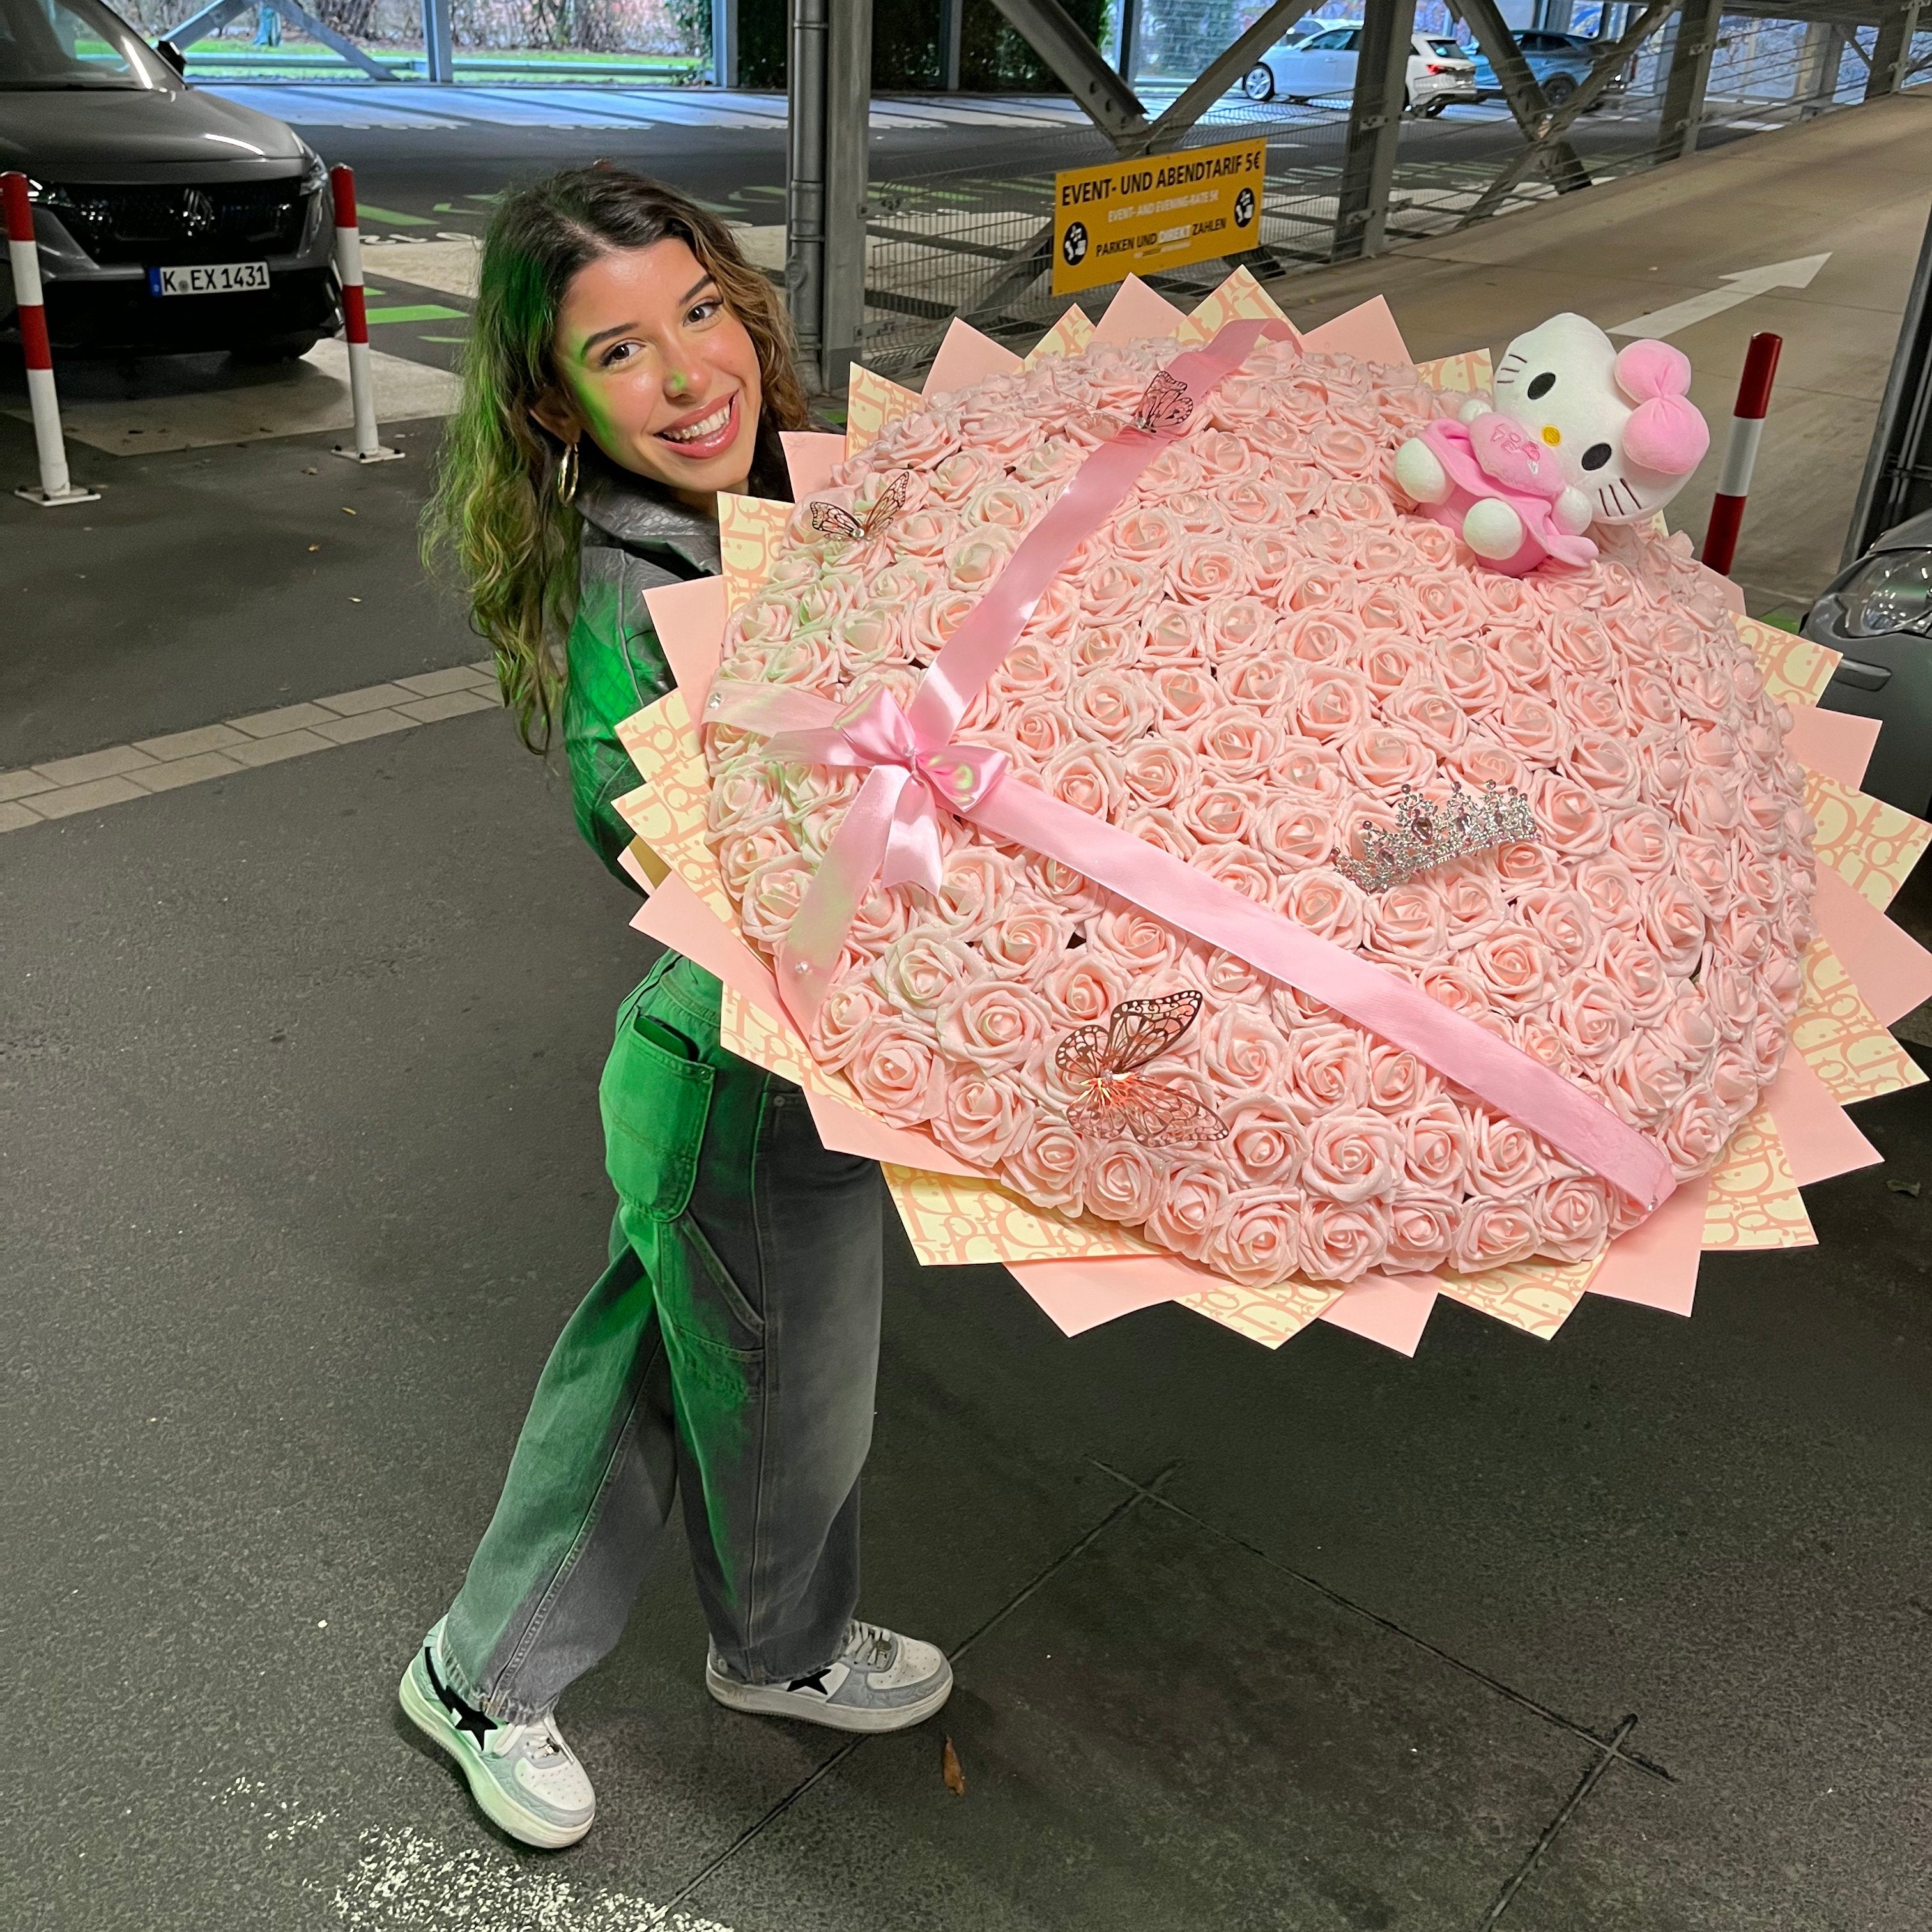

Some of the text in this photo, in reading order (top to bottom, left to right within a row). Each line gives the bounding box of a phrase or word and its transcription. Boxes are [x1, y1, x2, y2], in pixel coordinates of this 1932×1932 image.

[1062, 151, 1261, 206] EVENT- UND ABENDTARIF 5€
[1096, 236, 1134, 257] PARKEN
[1137, 233, 1158, 248] UND
[1192, 217, 1227, 236] ZAHLEN
[163, 270, 177, 292] K
[190, 269, 217, 290] EX
[221, 265, 267, 288] 1431
